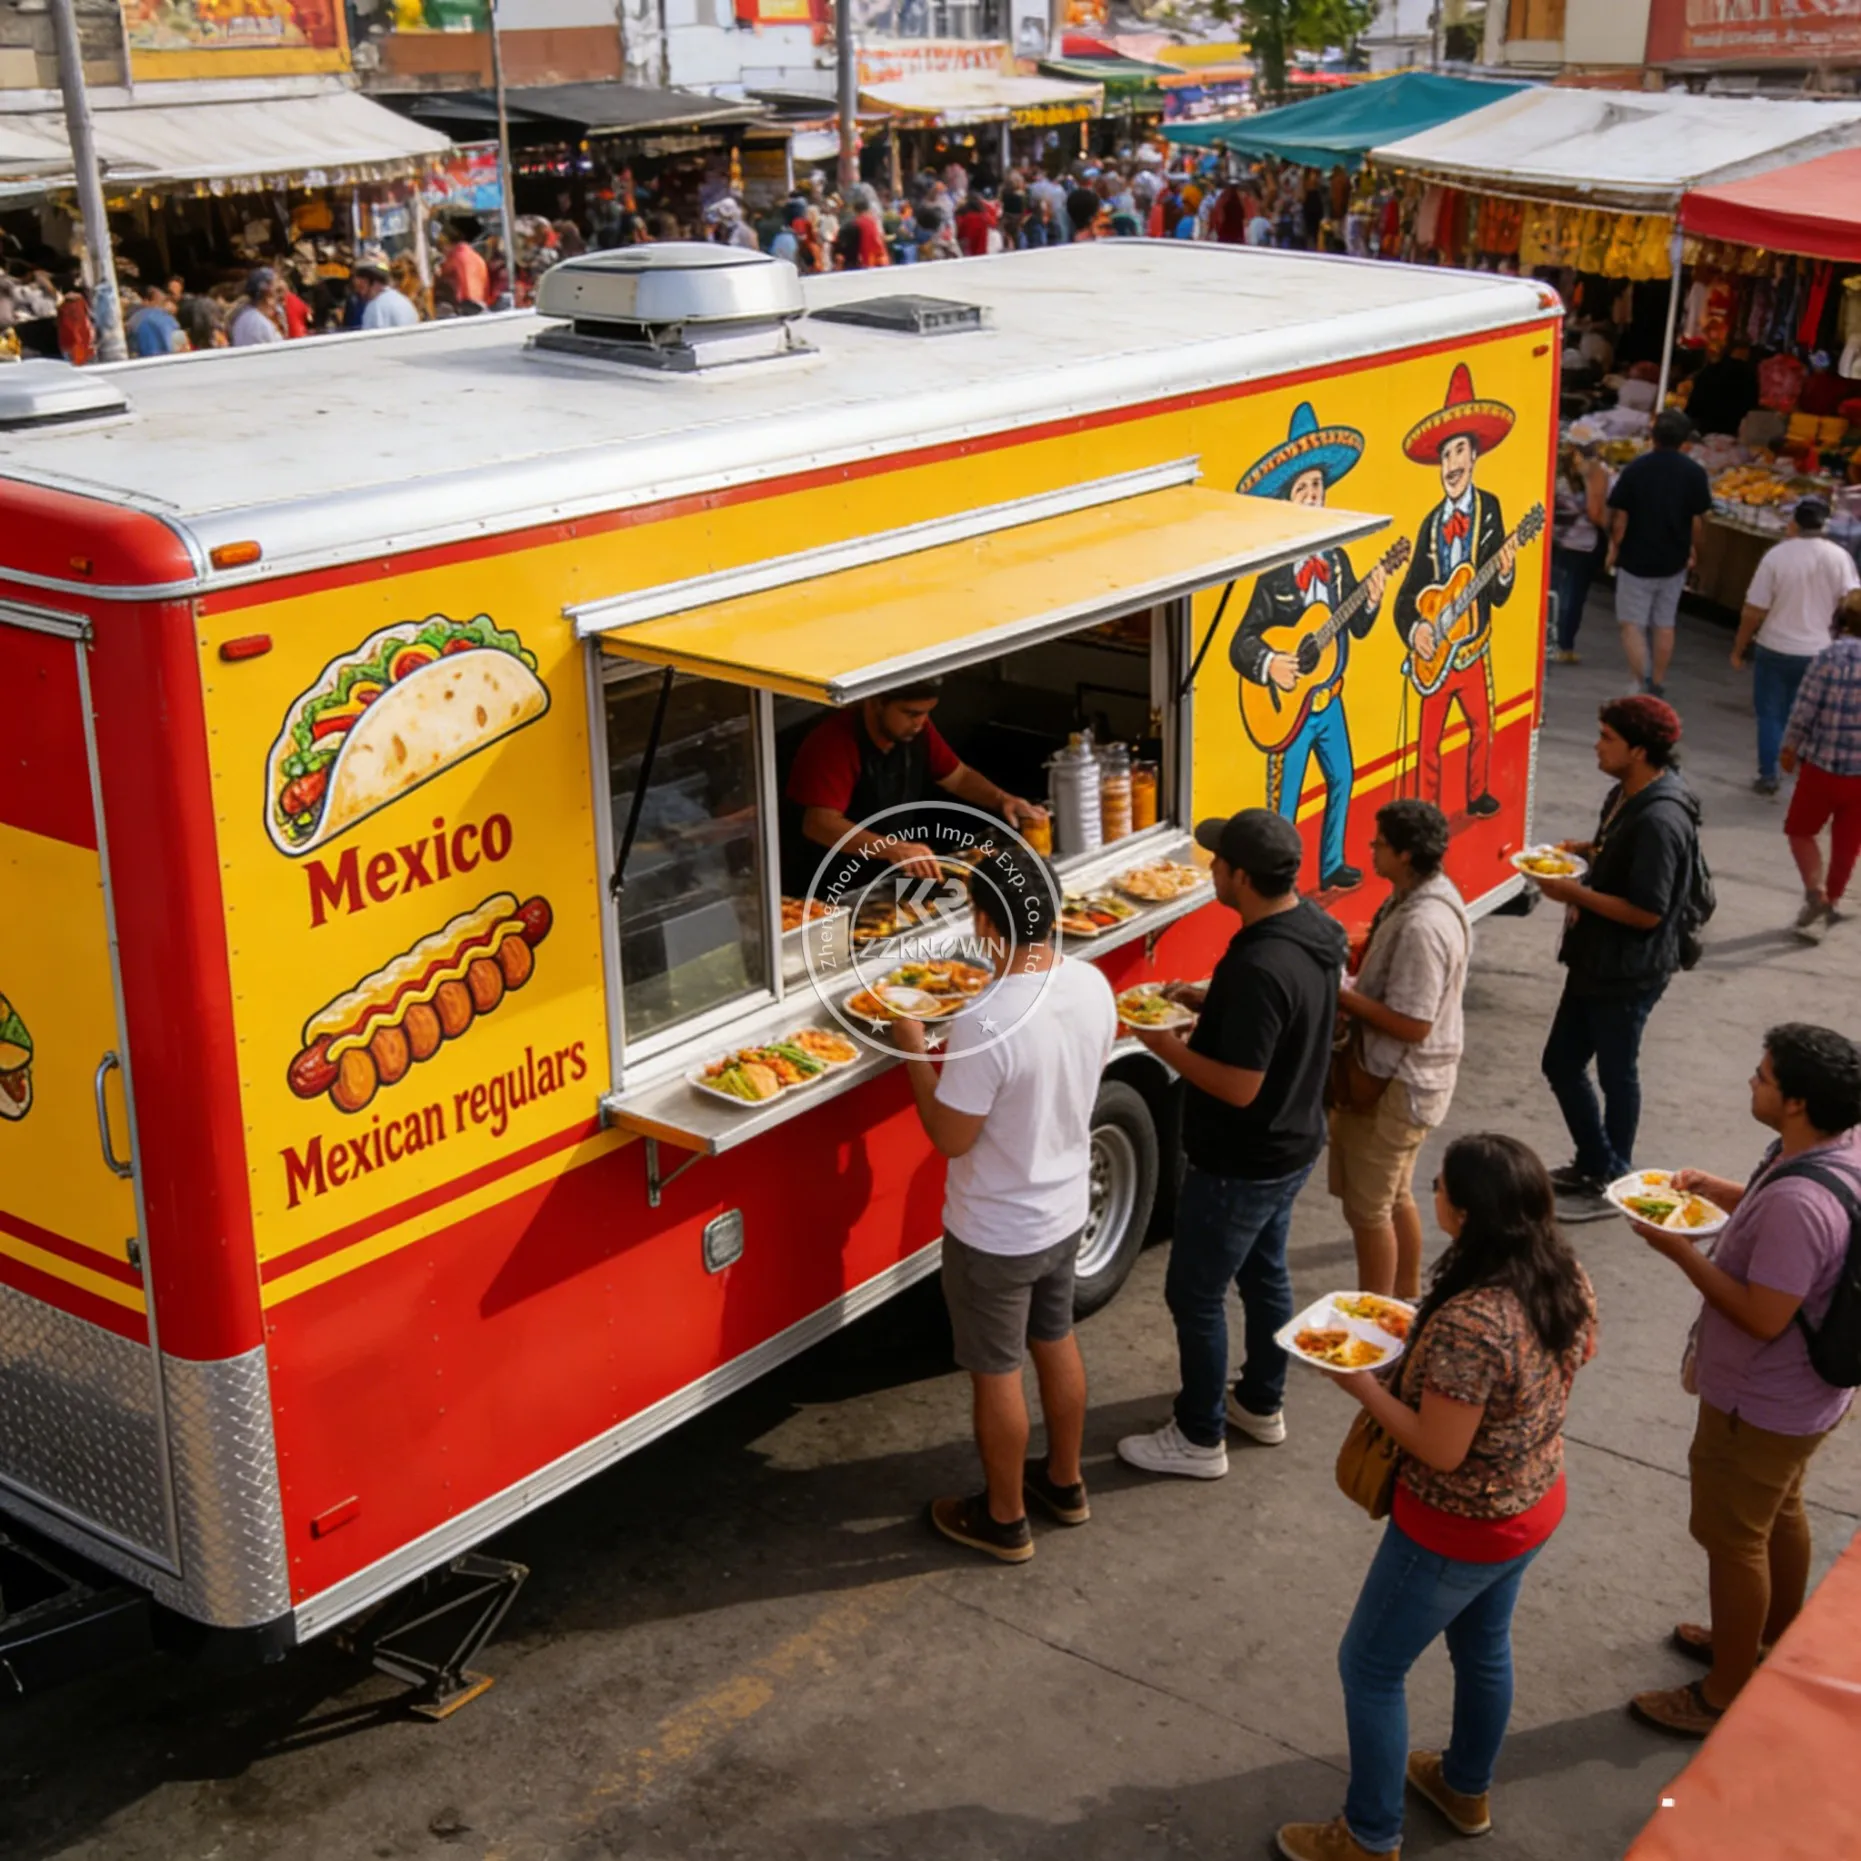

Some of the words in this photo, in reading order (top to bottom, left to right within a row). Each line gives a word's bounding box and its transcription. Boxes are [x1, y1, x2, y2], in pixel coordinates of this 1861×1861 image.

[302, 813, 513, 928] Mexico
[279, 1099, 447, 1210] Mexican
[453, 1041, 588, 1137] regulars
